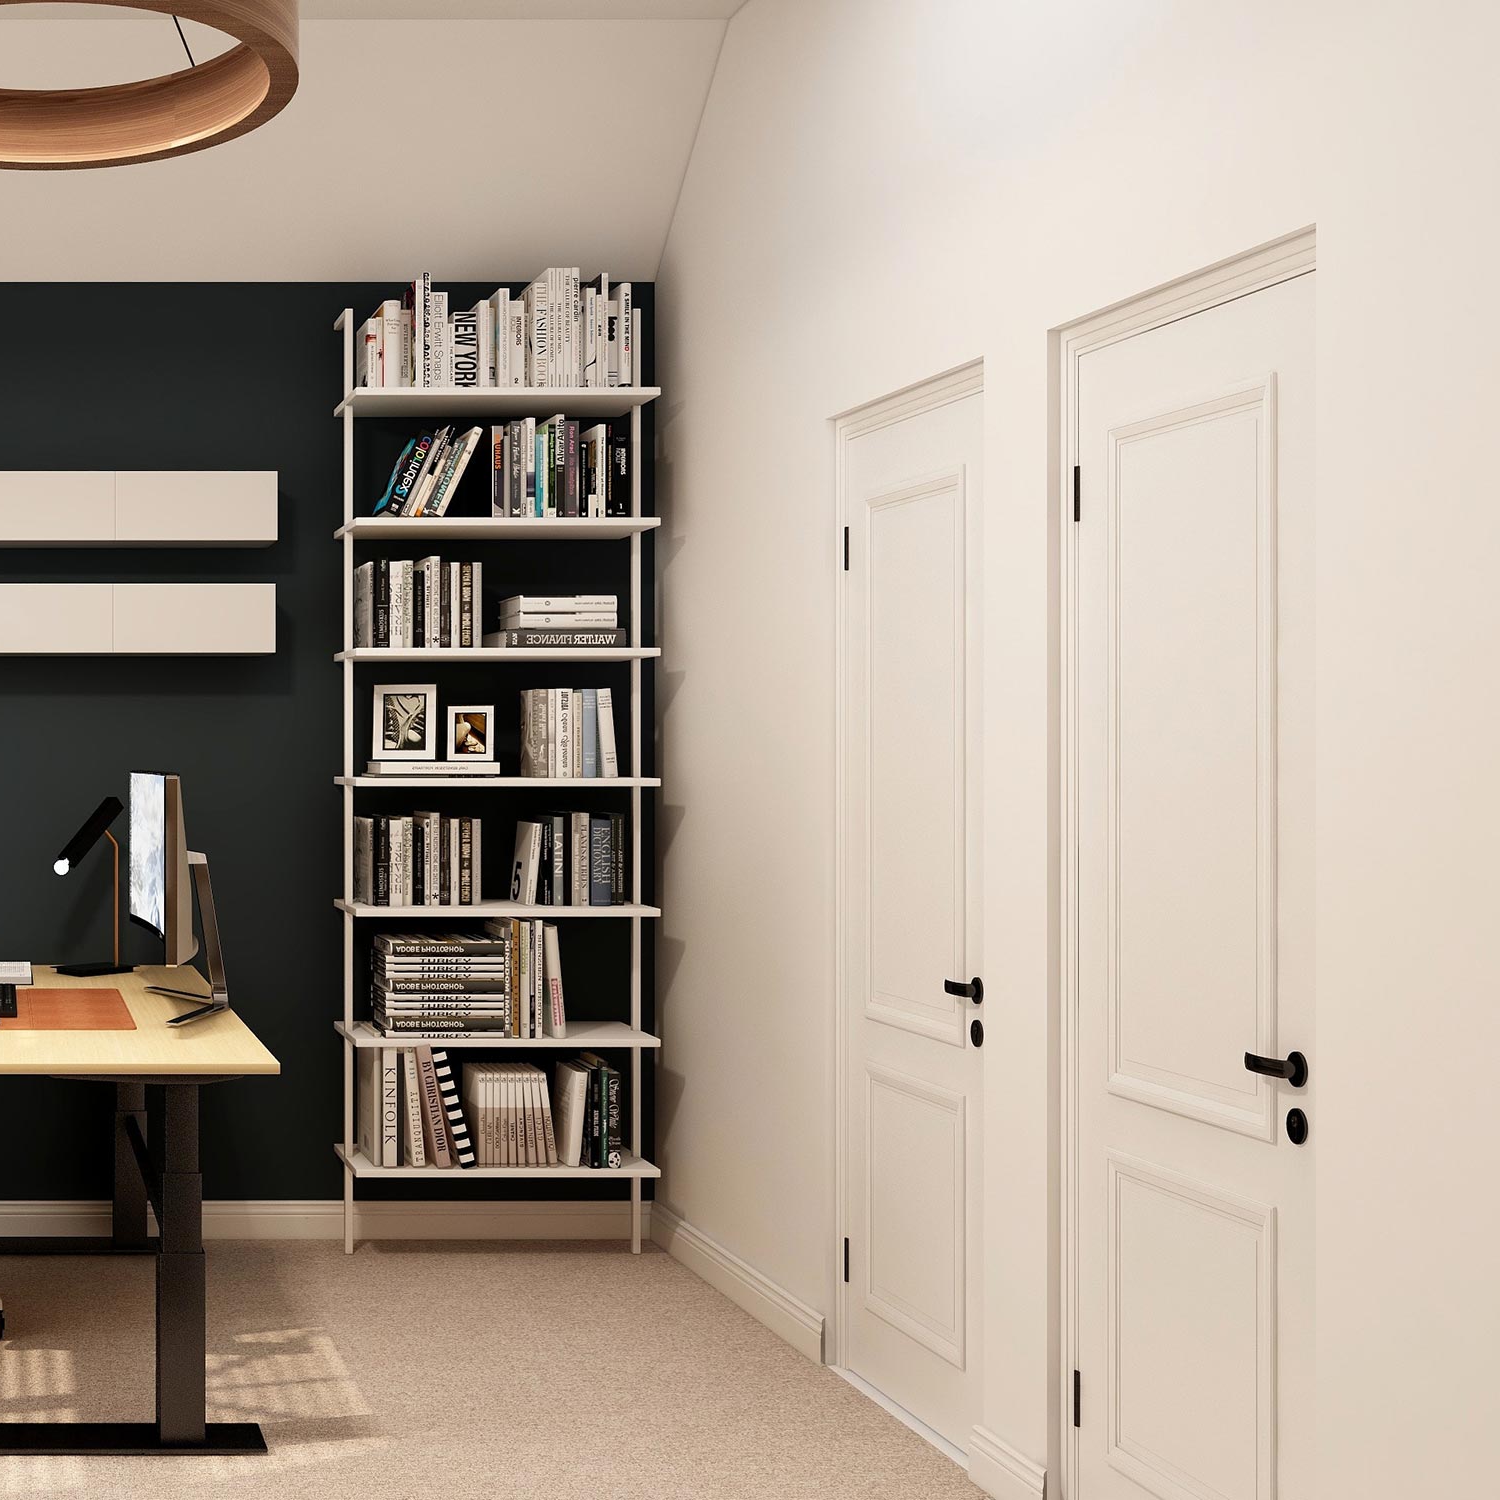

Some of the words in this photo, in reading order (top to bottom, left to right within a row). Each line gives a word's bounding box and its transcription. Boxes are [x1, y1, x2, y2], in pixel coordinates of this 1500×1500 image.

[434, 294, 444, 319] Elliott
[536, 283, 547, 306] THE
[434, 321, 444, 348] Erwitt
[454, 313, 477, 347] NEW
[536, 309, 547, 355] FASHION
[433, 350, 444, 381] Snaps
[554, 833, 563, 874] LATIN
[593, 827, 602, 884] DICTIONARY
[601, 827, 611, 884] ENGLISH
[421, 1061, 433, 1074] BY
[385, 1067, 396, 1144] KINFOLK
[425, 1075, 441, 1125] CHRISTIAN
[410, 1091, 424, 1163] TRANQUILITY
[434, 1128, 447, 1152] DIOR
